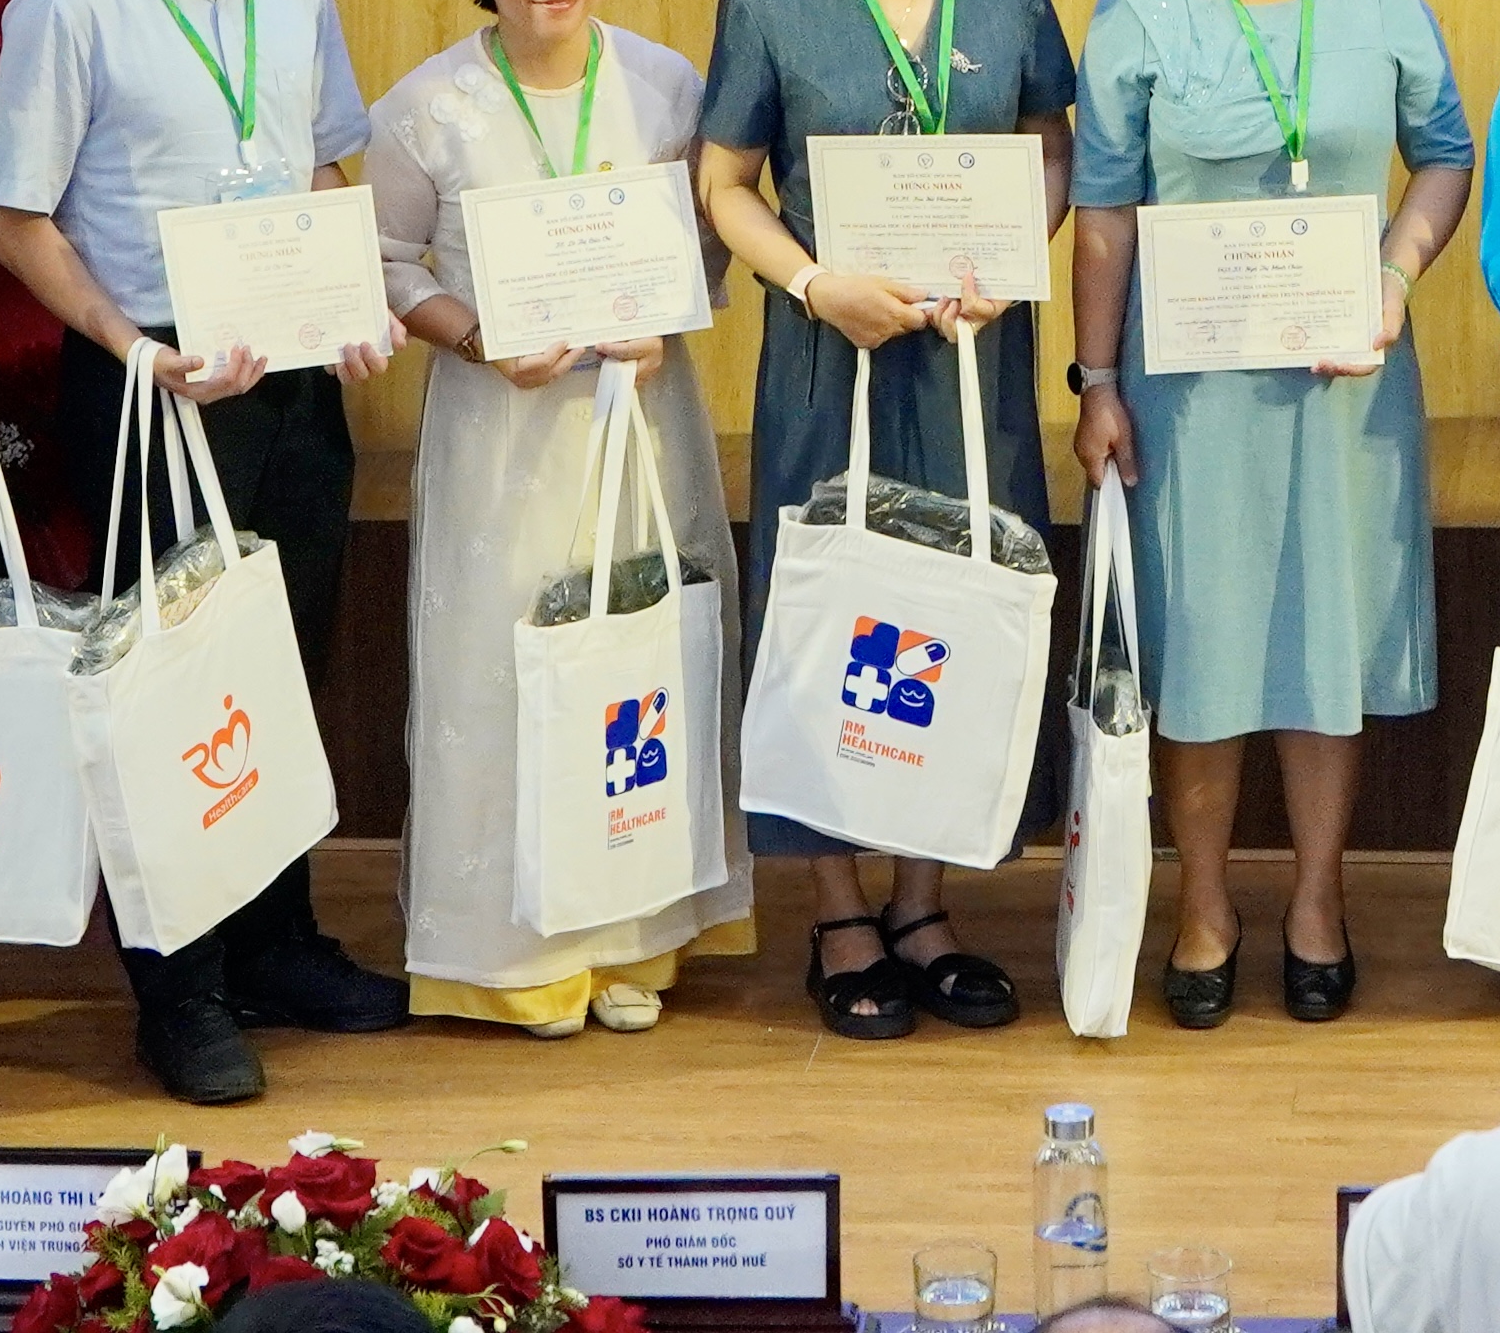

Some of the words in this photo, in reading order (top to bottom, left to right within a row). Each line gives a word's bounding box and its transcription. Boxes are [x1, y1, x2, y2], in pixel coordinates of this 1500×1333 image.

[845, 720, 865, 736] RM
[842, 734, 925, 767] HEALTHCARE
[208, 778, 254, 824] Healthcare
[611, 808, 623, 822] RM
[611, 807, 666, 835] HEALTHCARE
[0, 1188, 52, 1205] HOÀNG
[58, 1192, 82, 1209] THỊ
[585, 1207, 604, 1222] BS
[611, 1207, 641, 1222] CKII
[648, 1204, 700, 1222] HOÀNG
[707, 1207, 758, 1224] TRỌNG
[765, 1204, 796, 1220] QUÝ
[646, 1235, 670, 1249] PHÓ
[676, 1236, 706, 1248] GIÁM
[712, 1233, 736, 1248] ĐỐC
